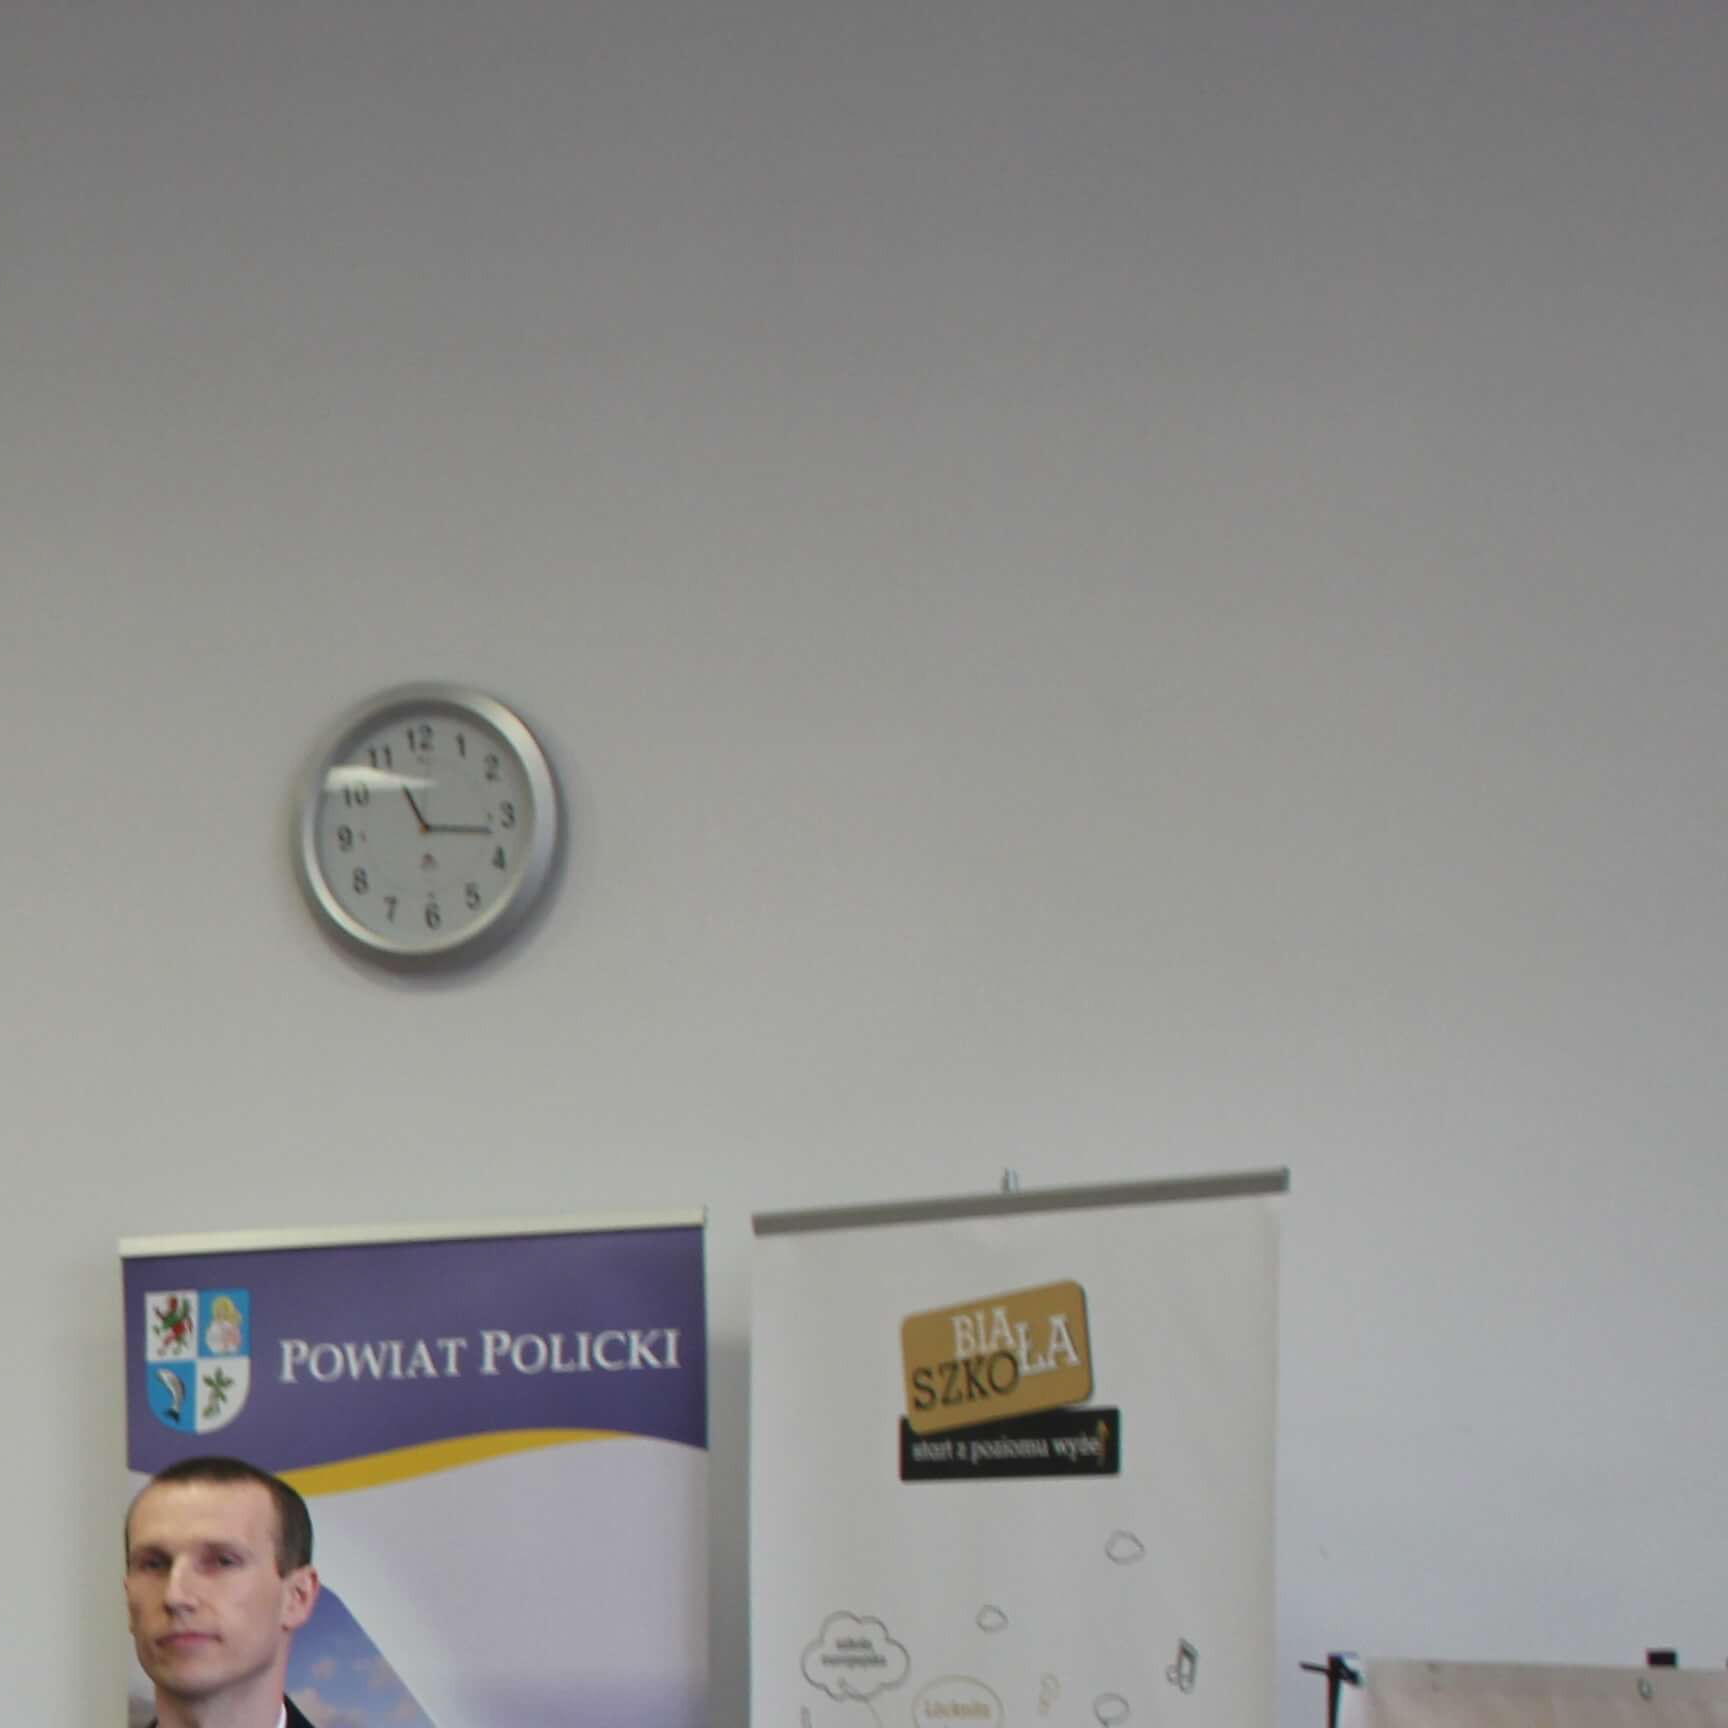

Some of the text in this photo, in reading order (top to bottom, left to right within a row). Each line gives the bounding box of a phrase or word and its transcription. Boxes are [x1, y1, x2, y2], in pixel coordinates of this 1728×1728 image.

[406, 724, 433, 751] 12
[456, 733, 467, 759] 1
[484, 753, 500, 781] 2
[501, 802, 516, 830] 3
[337, 826, 353, 853] 9
[493, 846, 507, 872] 4
[352, 866, 369, 895] 8
[384, 895, 399, 922] 7
[465, 881, 481, 910] 5
[425, 901, 442, 930] 6
[278, 1328, 680, 1384] POWIAT POLICKI
